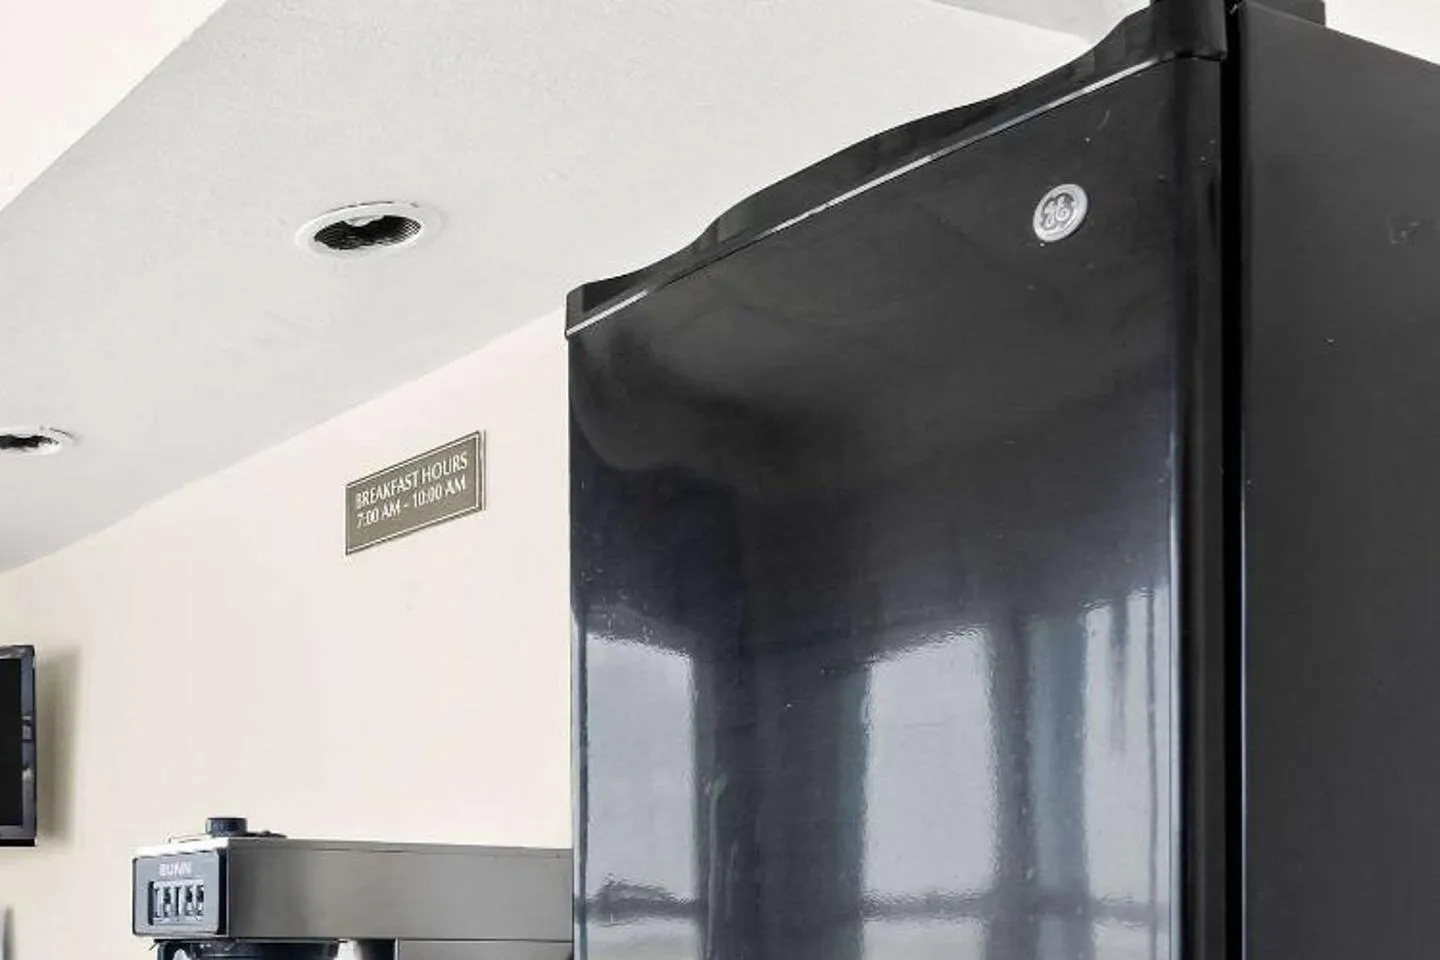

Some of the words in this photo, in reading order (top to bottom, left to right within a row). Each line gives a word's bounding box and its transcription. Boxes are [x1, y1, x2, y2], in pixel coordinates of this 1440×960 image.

[356, 471, 420, 509] BREAKFAST
[422, 451, 468, 485] HOURS
[356, 508, 379, 529] 7:00
[381, 498, 401, 521] AM
[413, 484, 443, 508] 10:00
[444, 474, 467, 496] AM
